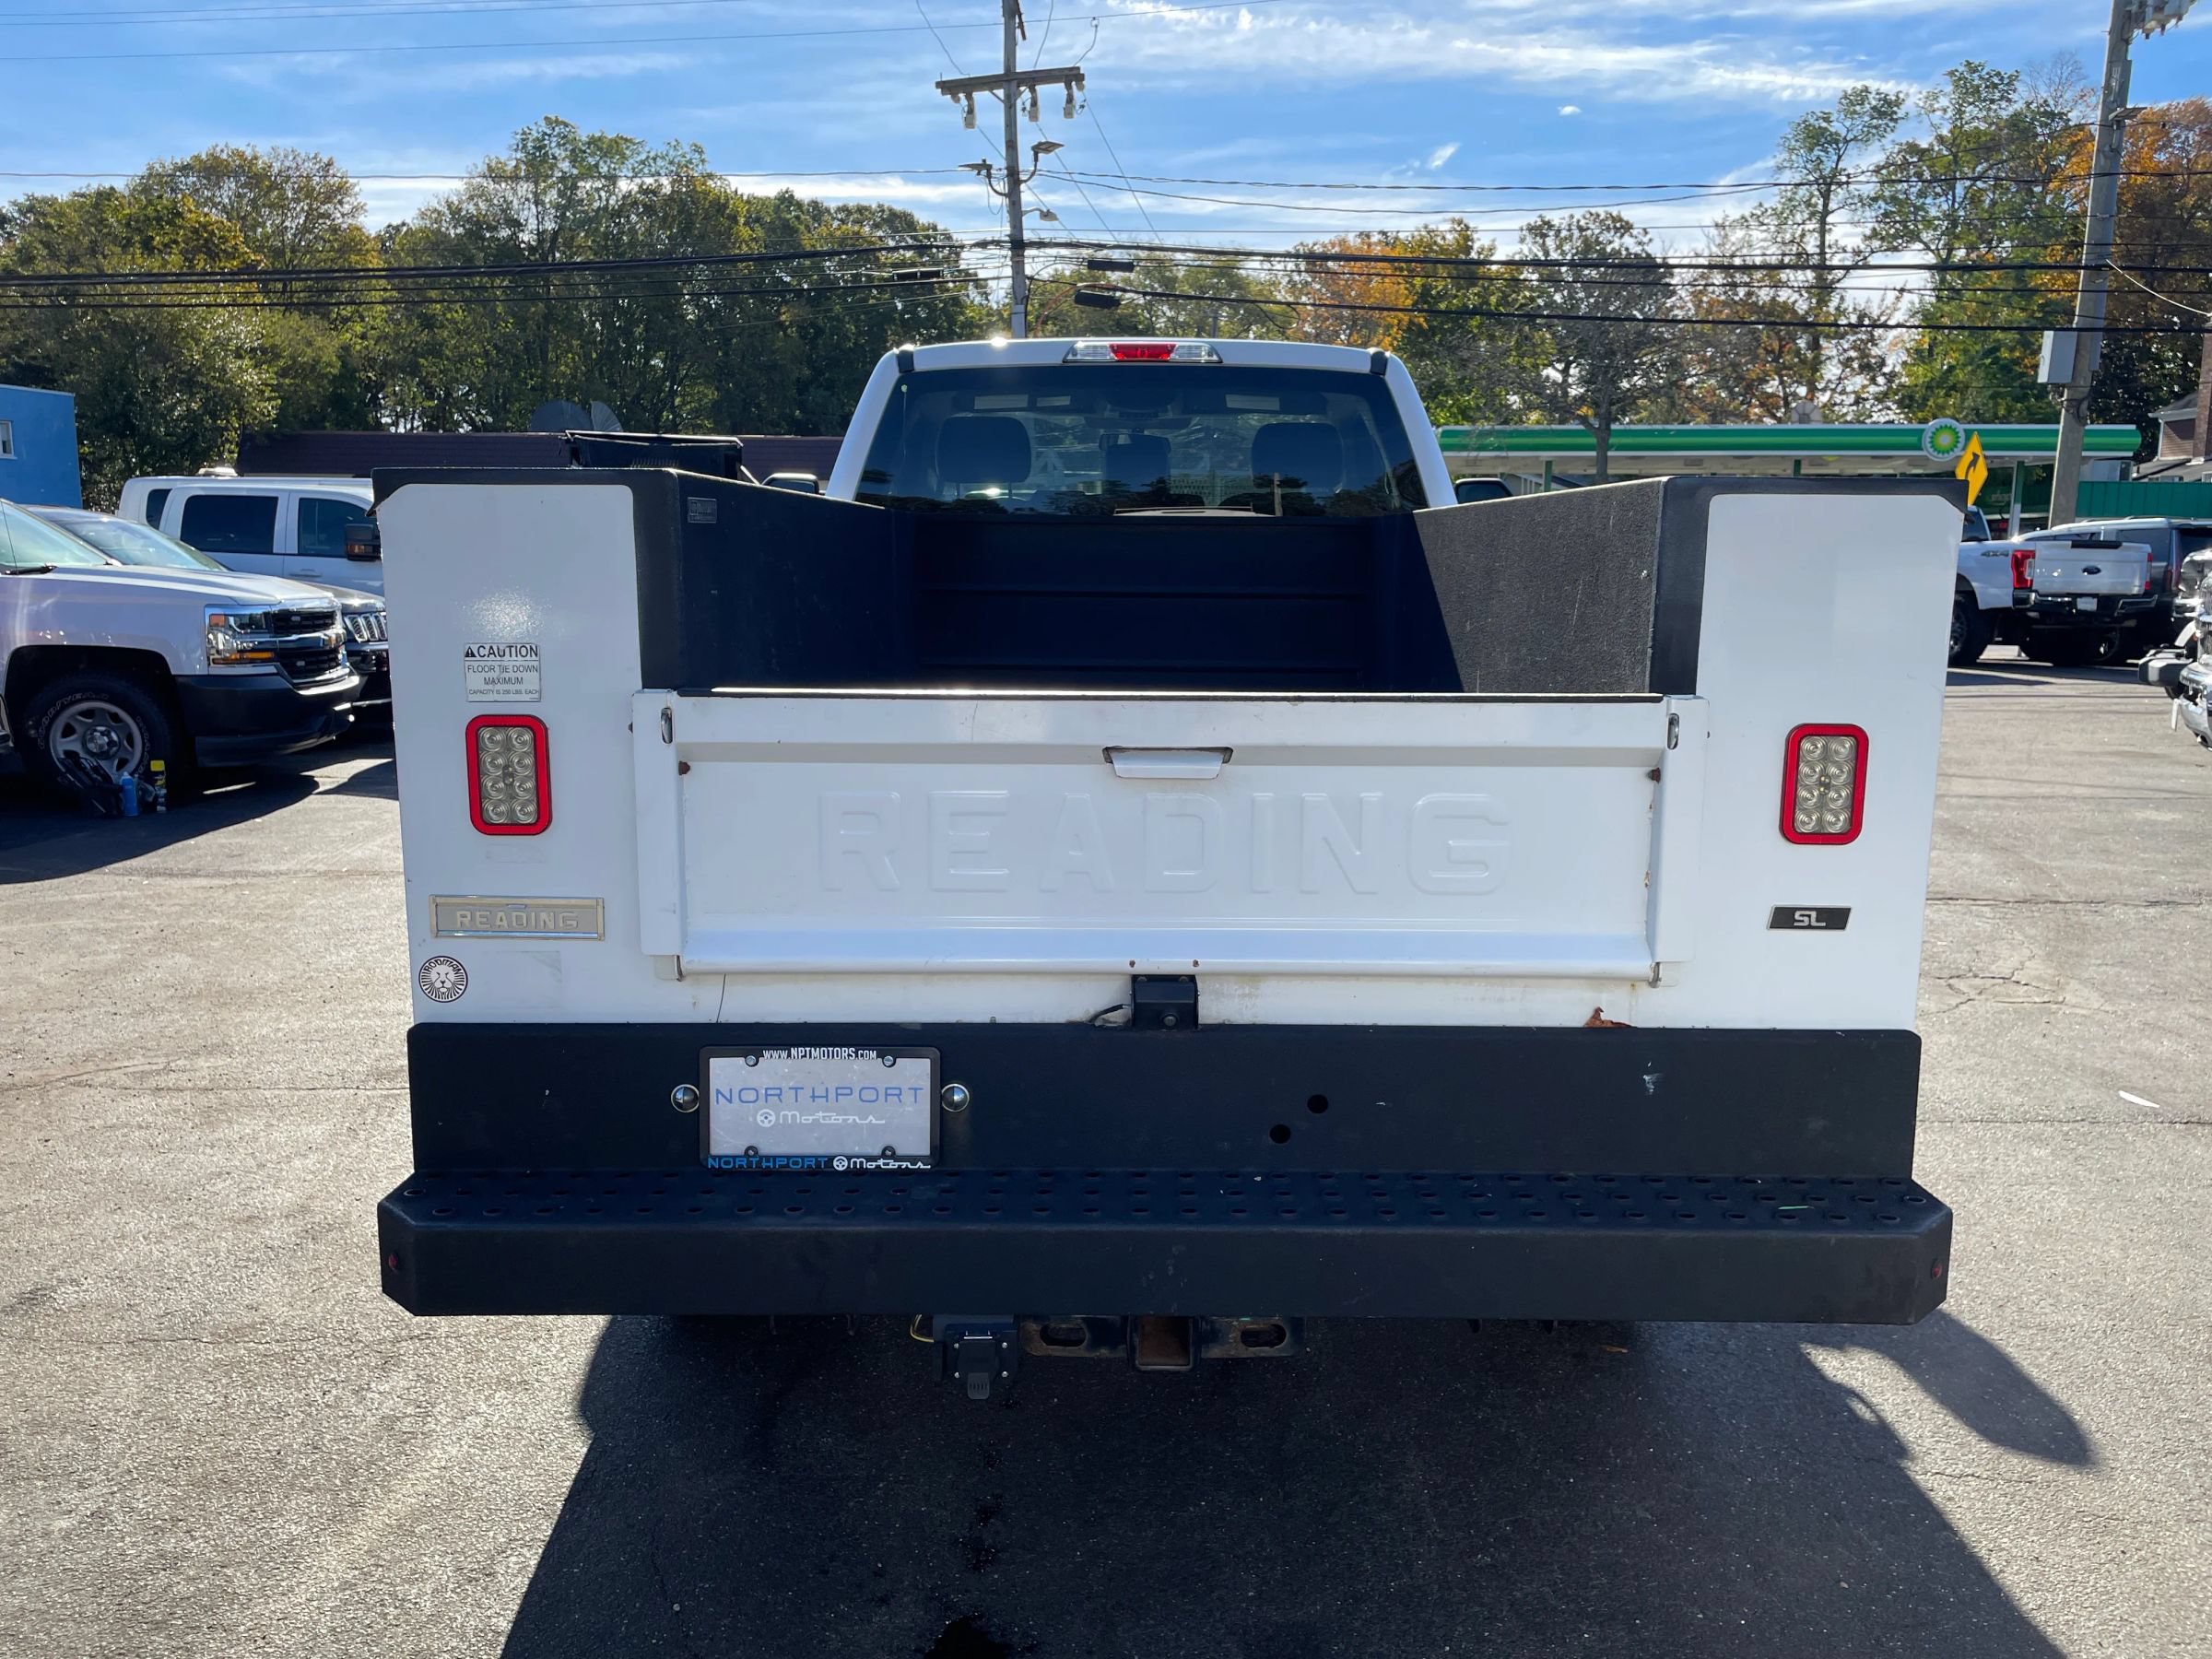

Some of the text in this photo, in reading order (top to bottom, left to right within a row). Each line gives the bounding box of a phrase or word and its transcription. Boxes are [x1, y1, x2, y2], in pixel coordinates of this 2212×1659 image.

[477, 644, 538, 658] CAUTION
[467, 665, 538, 674] FLOOR TIE DOWN
[484, 677, 524, 685] MAXIMUM
[818, 788, 1513, 896] READING
[455, 910, 580, 930] READING
[1793, 910, 1827, 927] SL
[423, 958, 462, 974] RODMAN
[762, 1047, 877, 1061] WWW.NPTMOTORS.COM
[715, 1086, 924, 1105] NORTHPORT
[780, 1110, 886, 1124] Motors
[707, 1156, 932, 1171] NORTHPORT Motors
